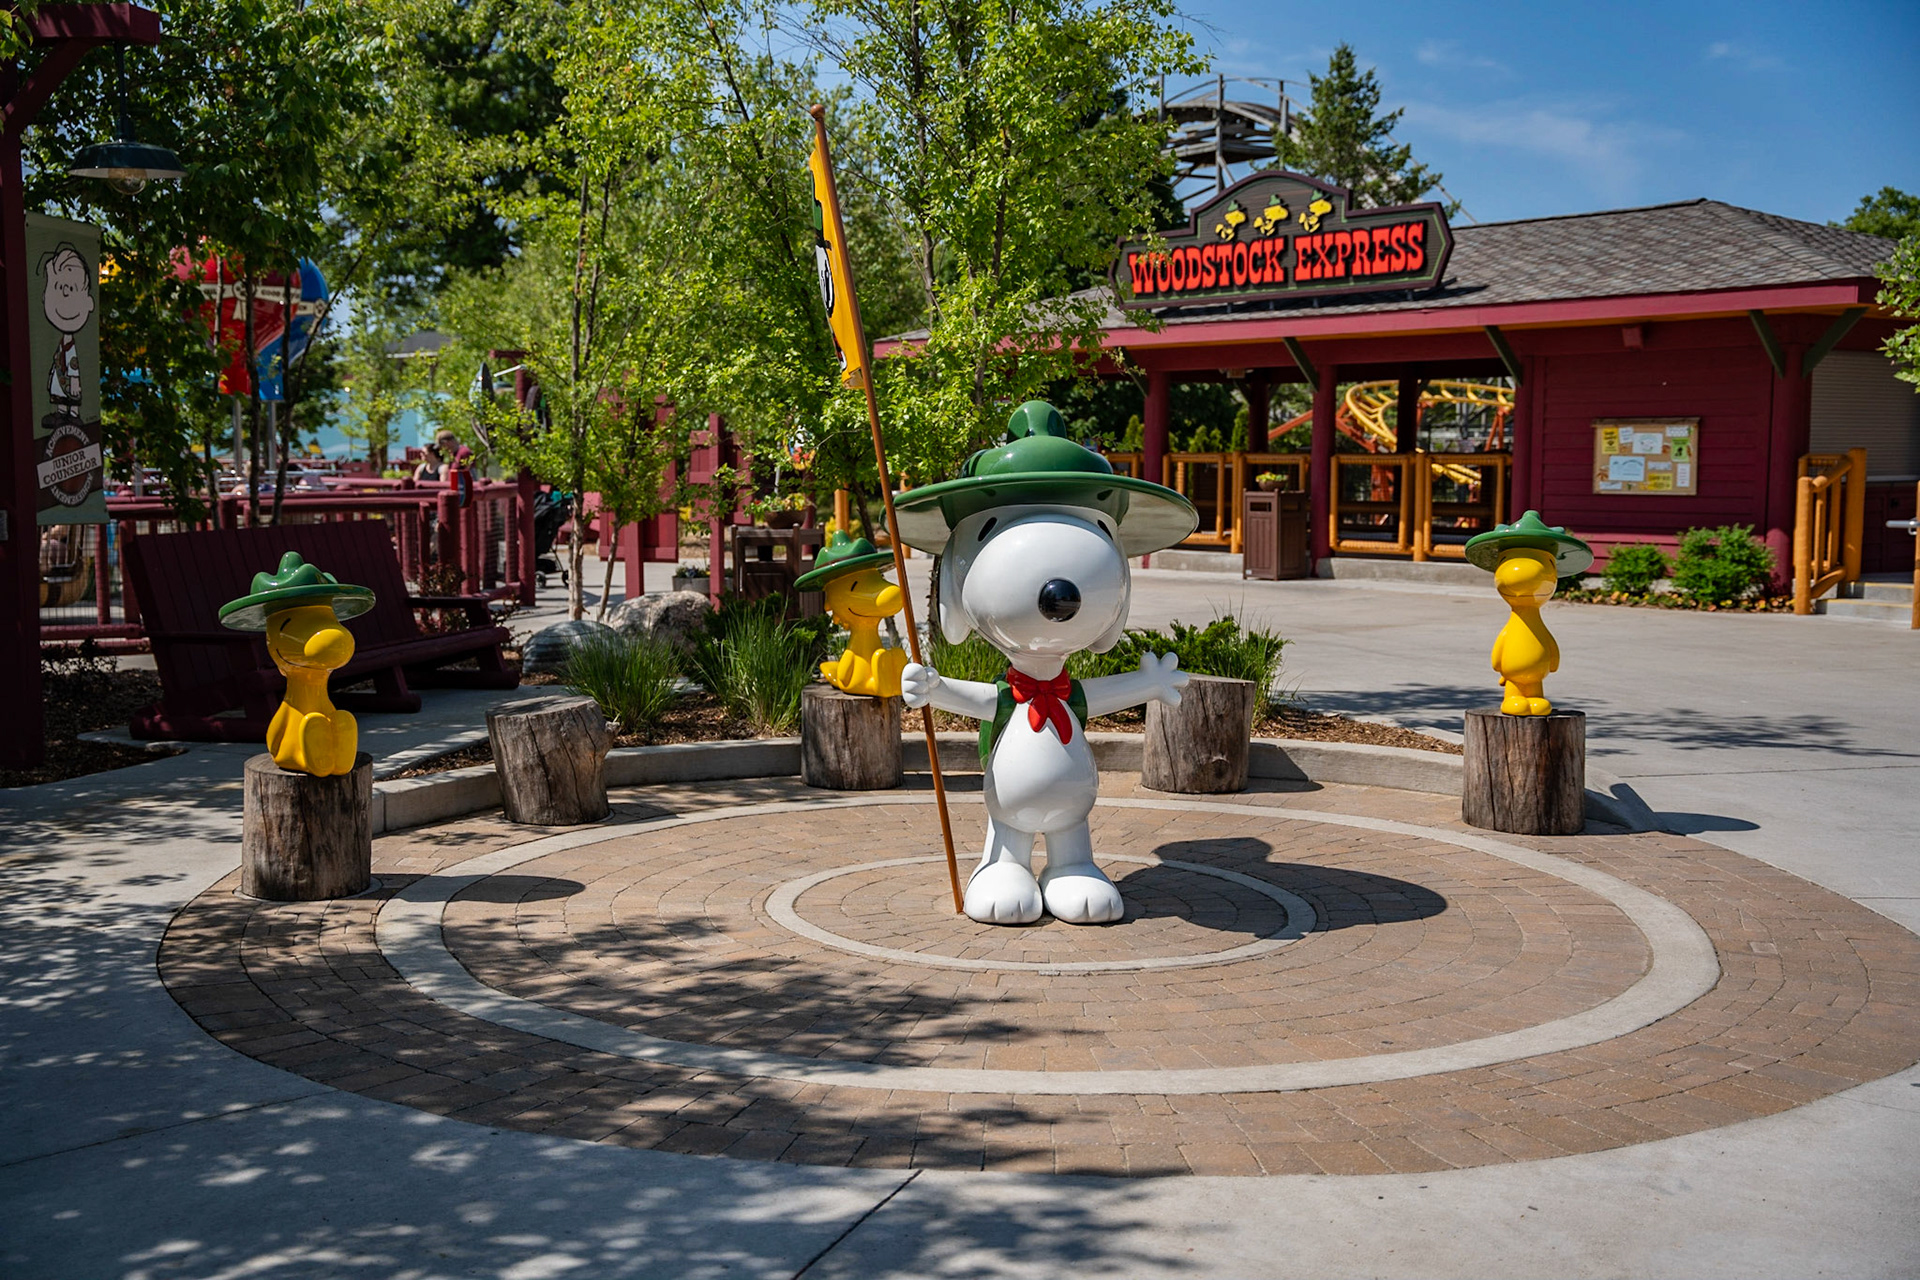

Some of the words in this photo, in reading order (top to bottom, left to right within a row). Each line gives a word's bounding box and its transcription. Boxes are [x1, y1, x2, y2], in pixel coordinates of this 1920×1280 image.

[1129, 237, 1285, 293] WOODSTOCK
[1294, 222, 1424, 282] EXPRESS
[45, 425, 90, 458] ACHIEVEMENT
[43, 457, 98, 485] COUNSELOR
[53, 450, 86, 470] JUNIOR
